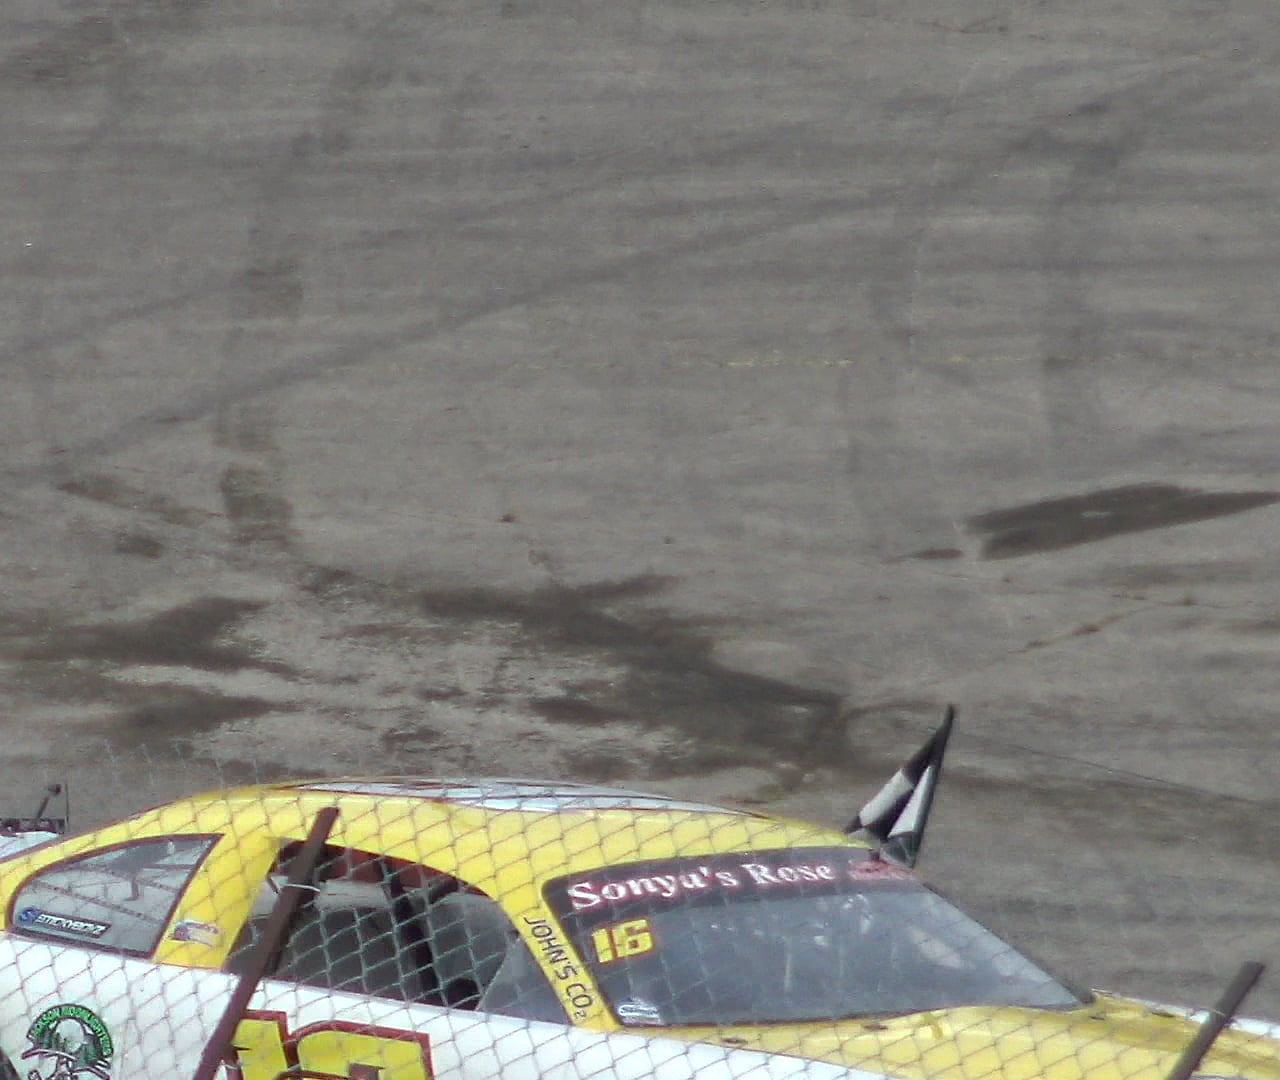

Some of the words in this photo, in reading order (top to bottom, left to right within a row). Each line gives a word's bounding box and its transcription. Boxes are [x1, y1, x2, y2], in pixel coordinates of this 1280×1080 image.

[567, 864, 740, 910] Sonya's
[740, 861, 837, 886] Rose
[523, 916, 578, 981] JOHN'S
[592, 918, 653, 964] 16
